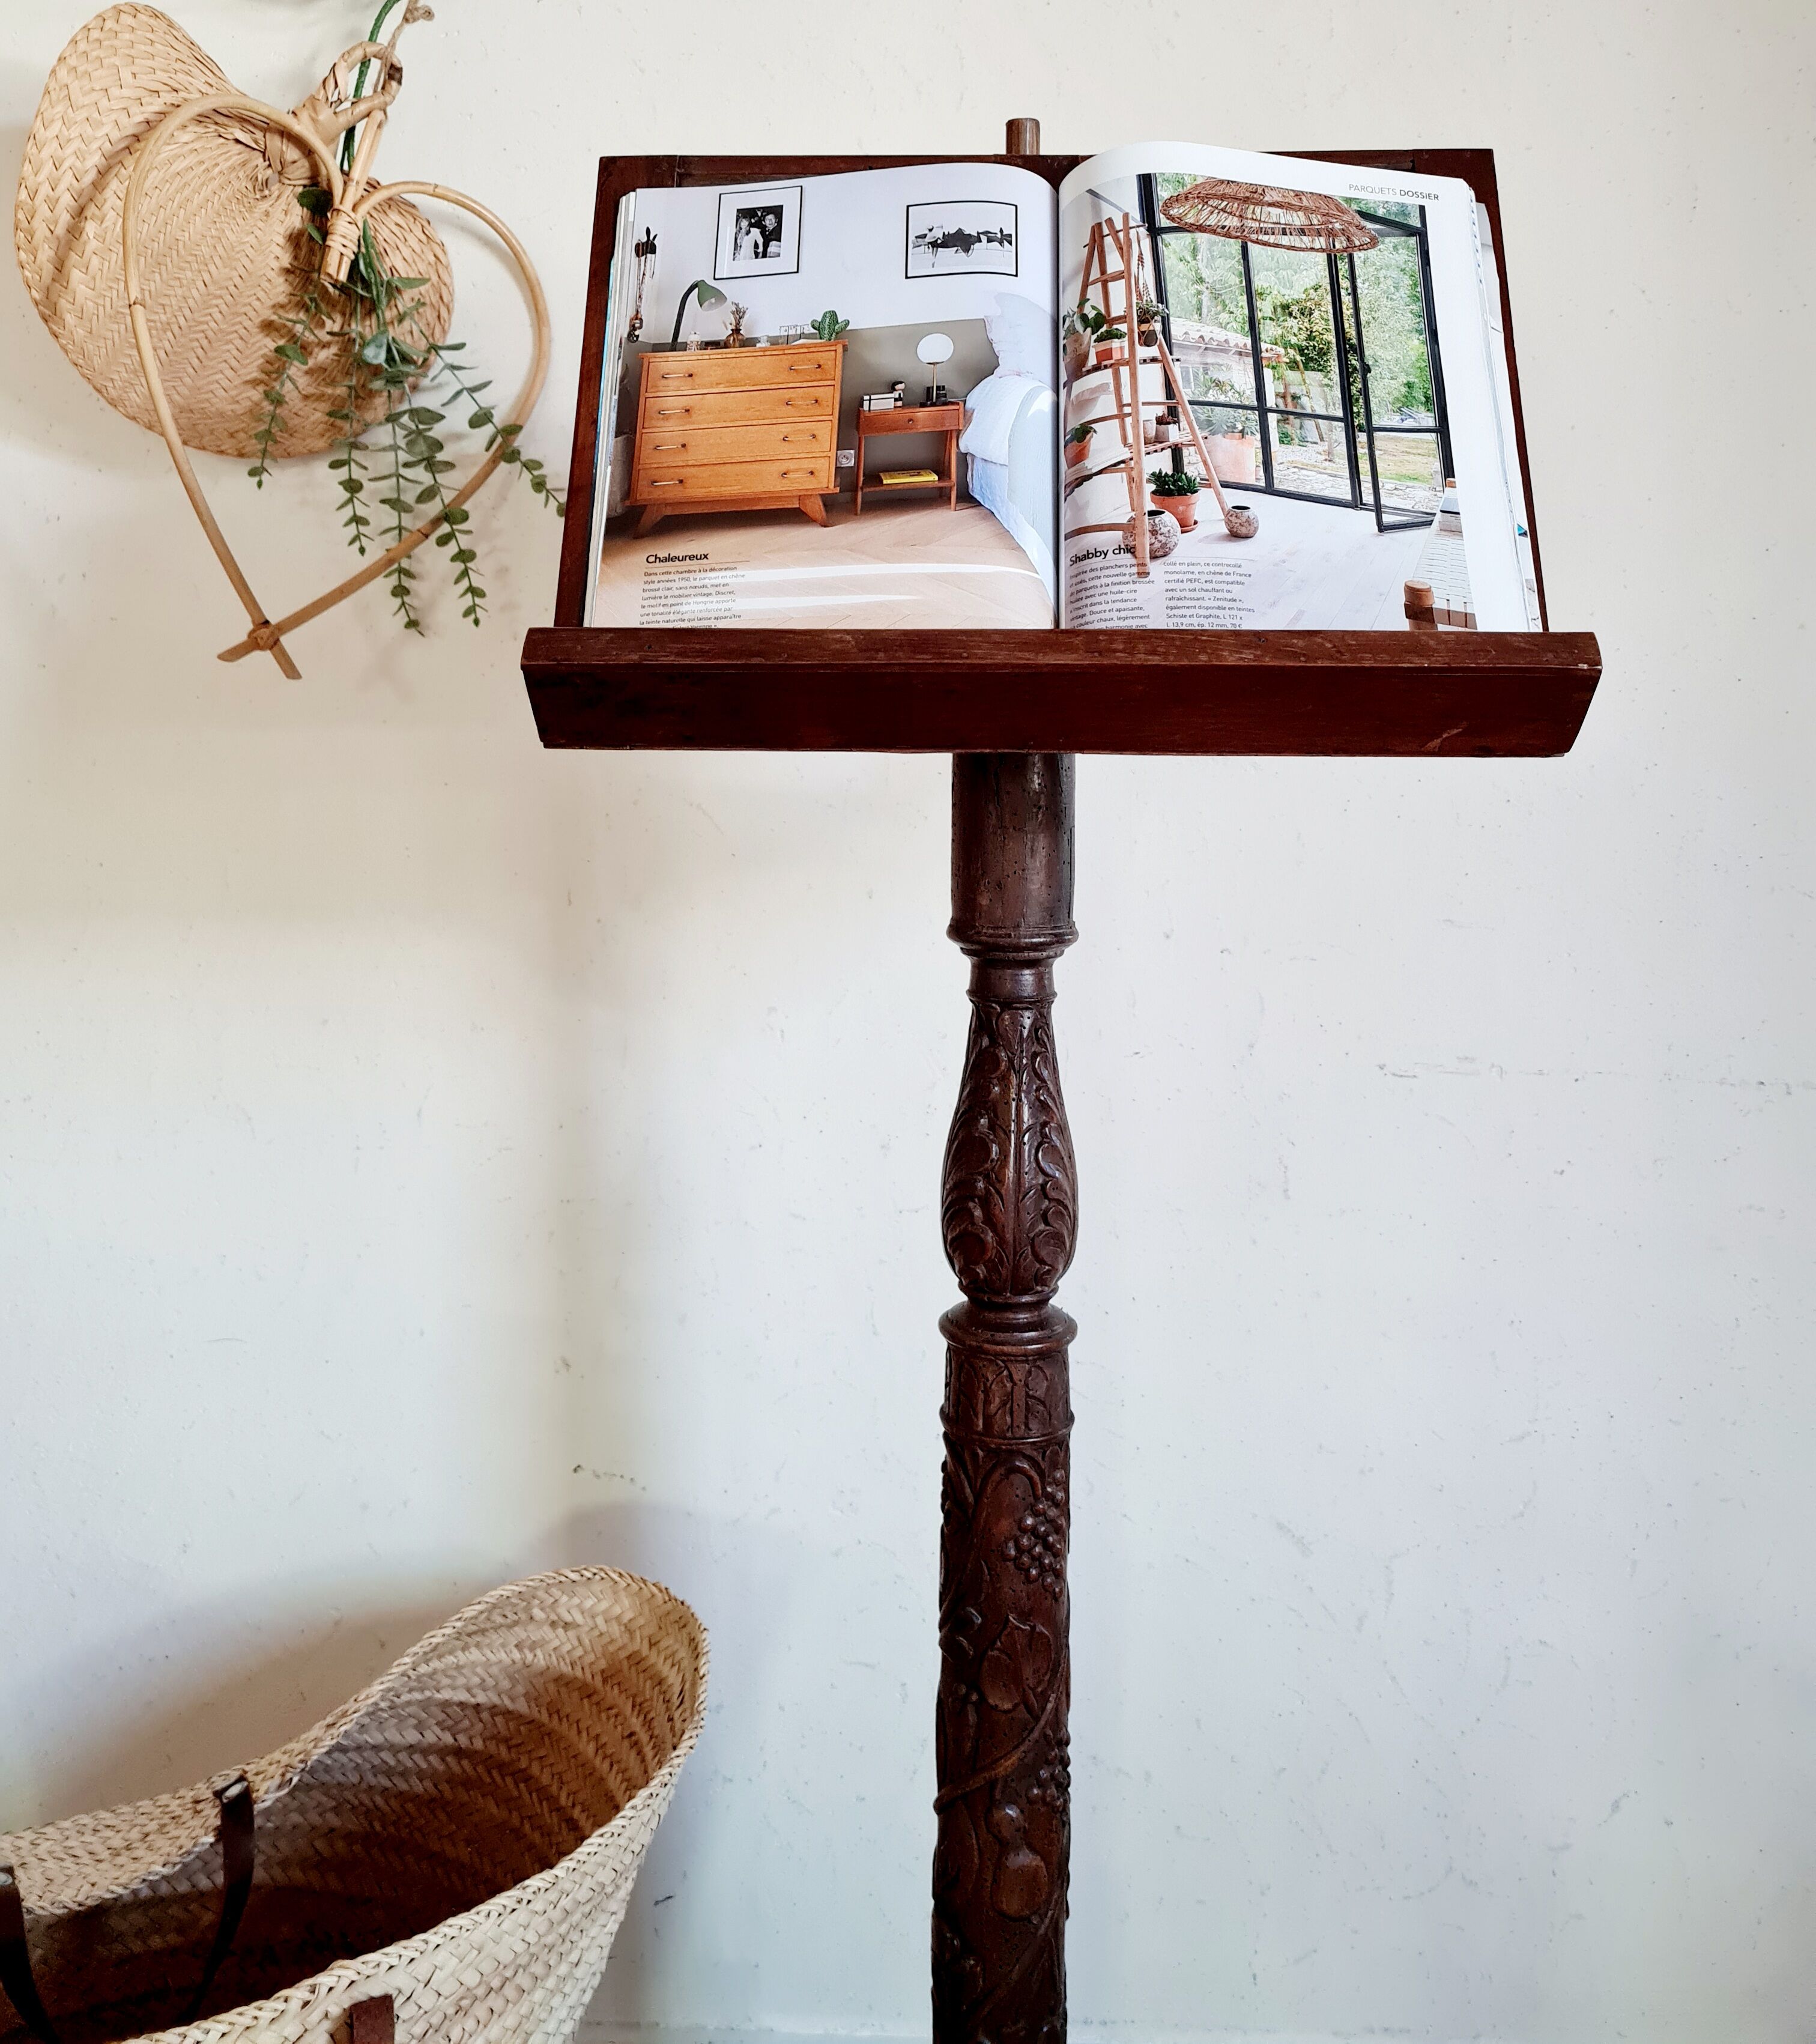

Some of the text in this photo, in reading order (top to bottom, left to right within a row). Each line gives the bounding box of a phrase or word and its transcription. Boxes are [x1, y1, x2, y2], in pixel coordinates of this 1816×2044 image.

[1349, 184, 1439, 201] PARQUETS DOSSIER
[646, 553, 709, 564] Chaleureux
[1070, 547, 1109, 567] Shabby
[1100, 563, 1128, 572] planchers
[698, 574, 720, 583] parquet
[1076, 584, 1098, 595] parquets
